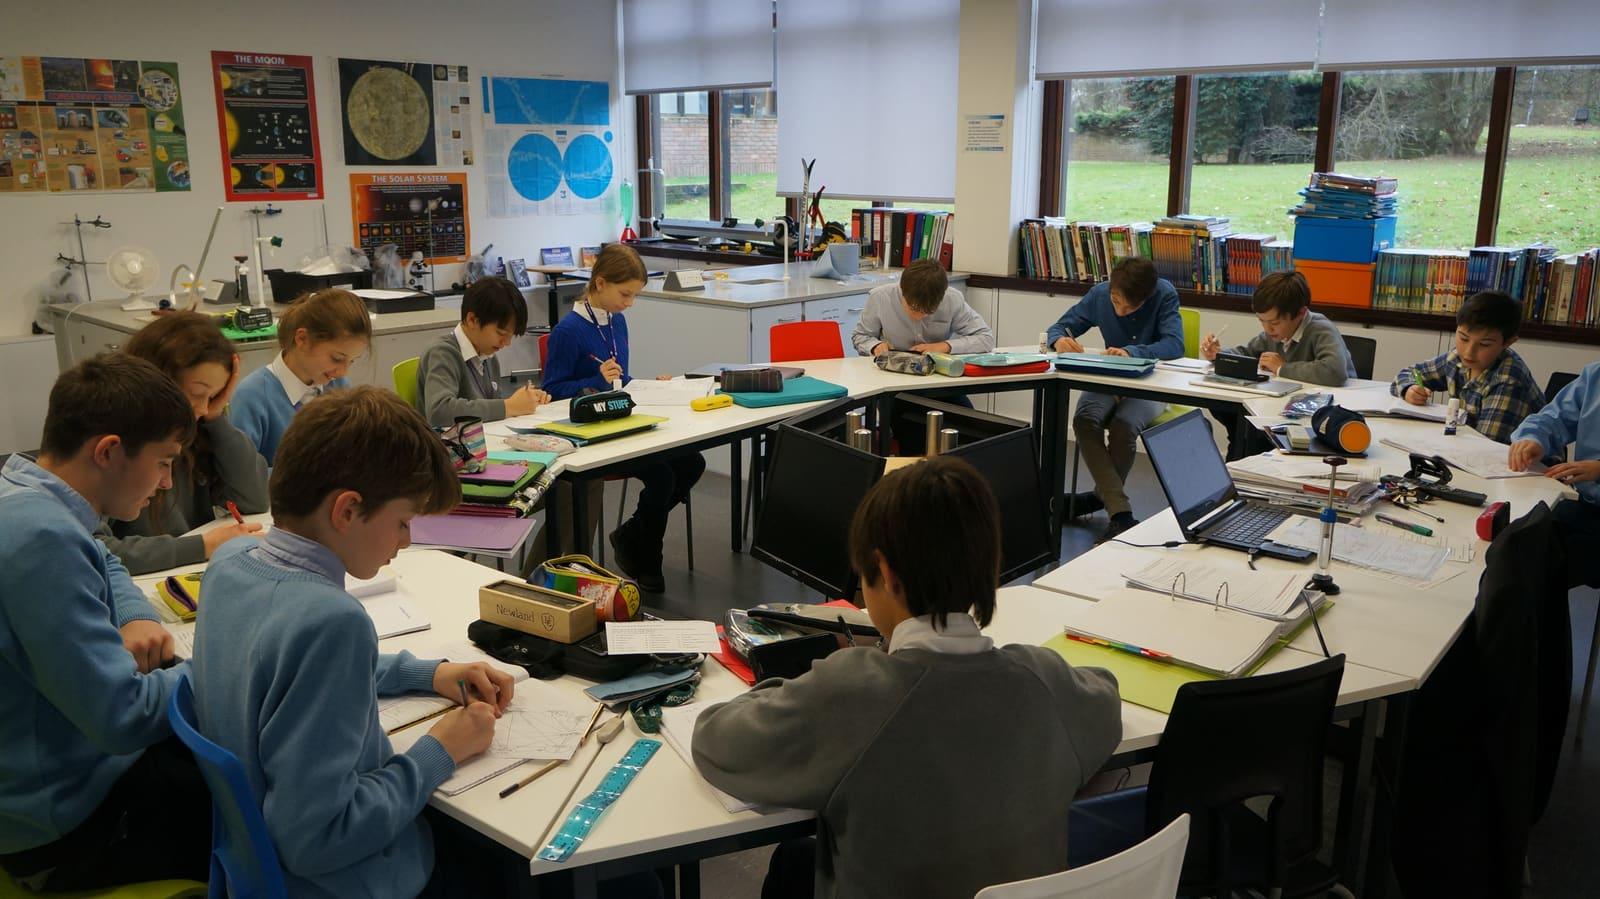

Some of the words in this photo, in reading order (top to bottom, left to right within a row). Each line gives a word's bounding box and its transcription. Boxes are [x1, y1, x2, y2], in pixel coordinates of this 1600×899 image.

[234, 54, 253, 64] THE
[255, 55, 285, 65] MOON
[372, 175, 387, 183] THE
[389, 174, 415, 183] SOLAR
[417, 174, 448, 183] SYSTEM
[593, 401, 606, 412] MY
[607, 399, 630, 410] STUFF
[496, 603, 535, 623] Newland
